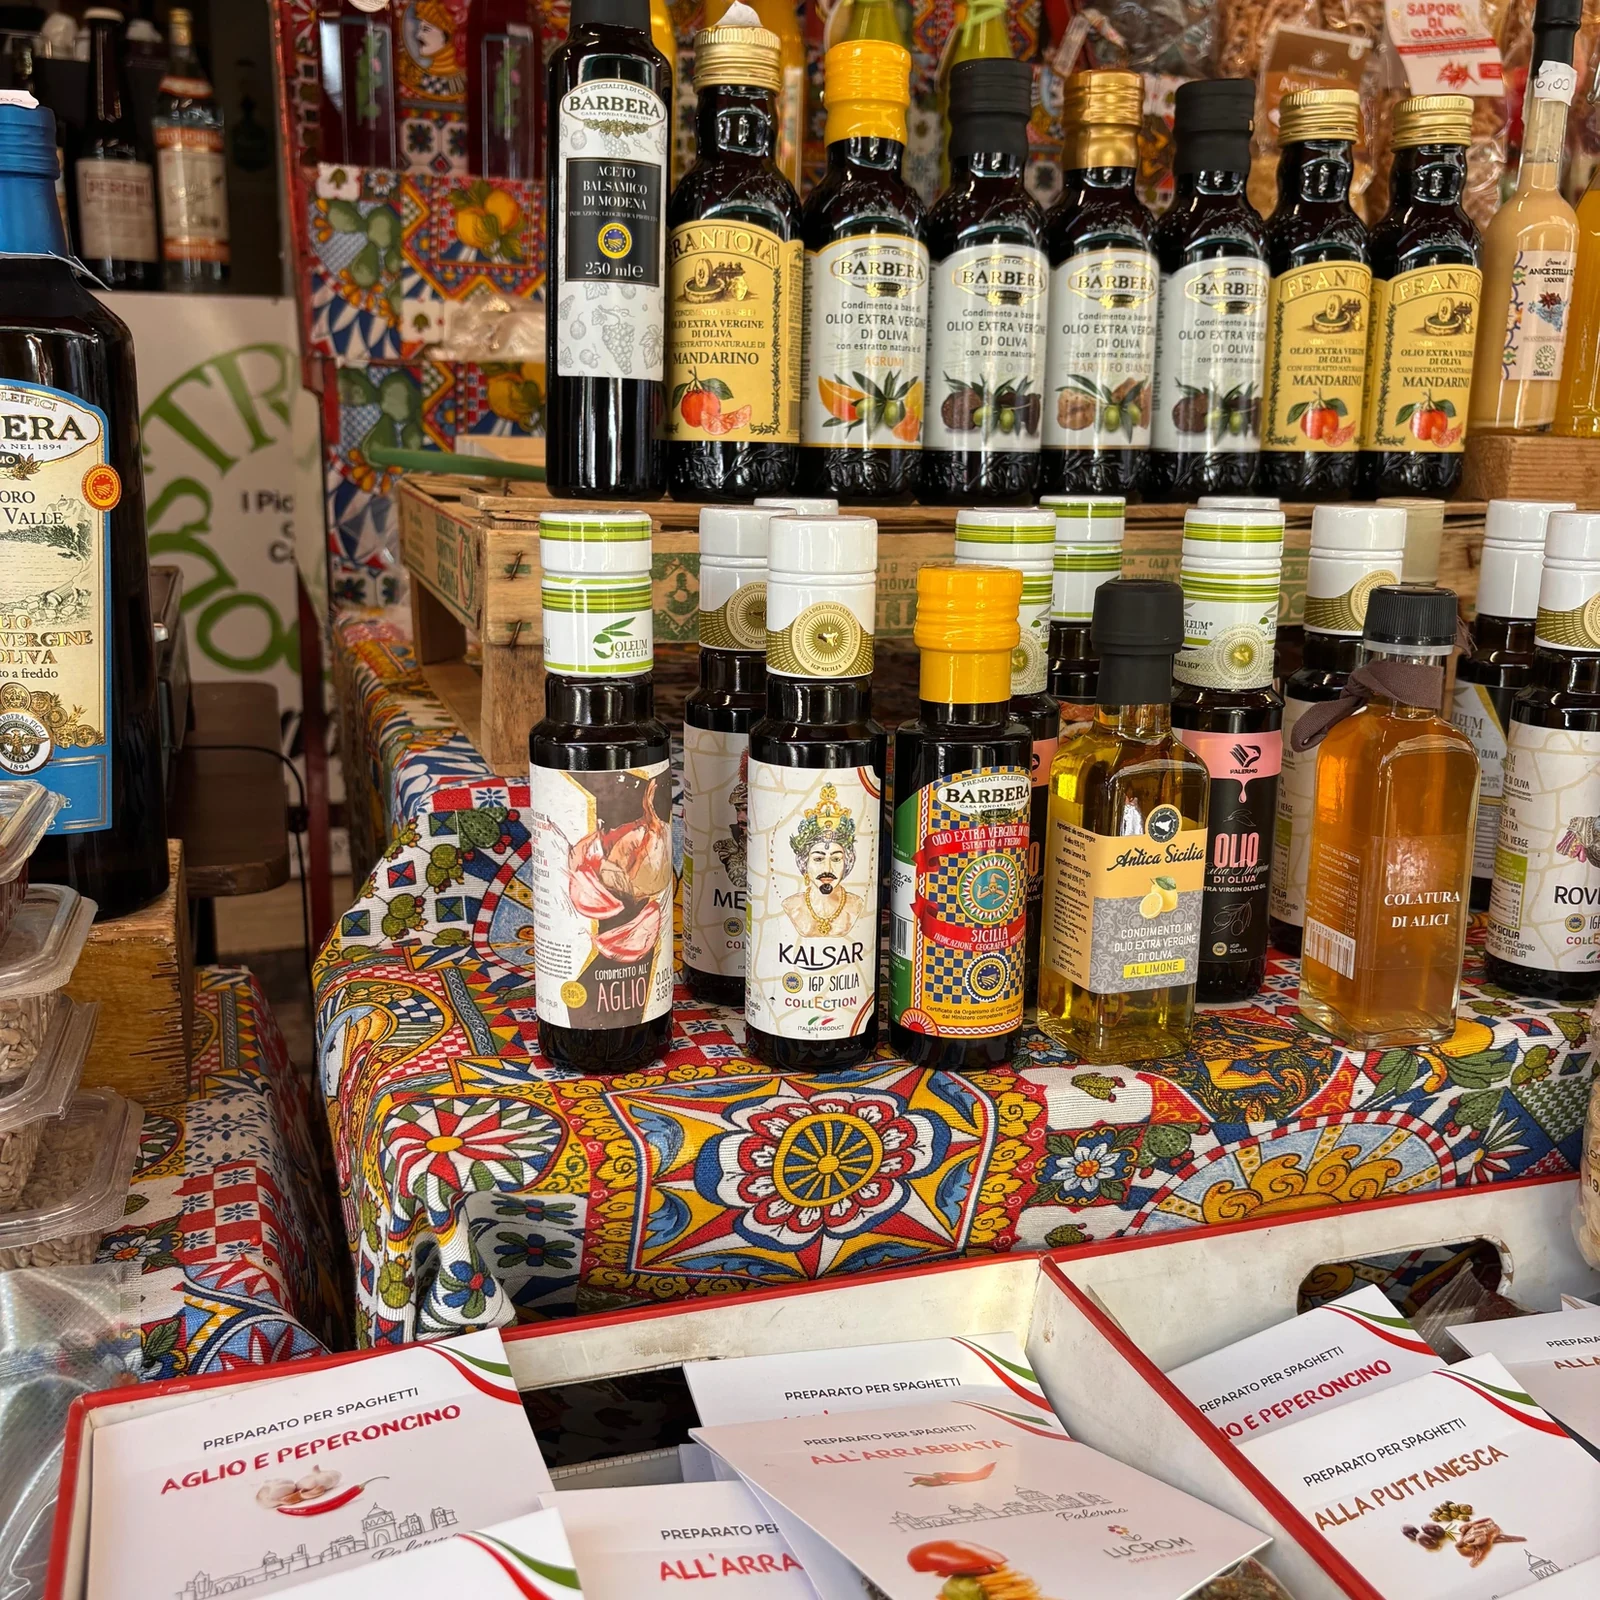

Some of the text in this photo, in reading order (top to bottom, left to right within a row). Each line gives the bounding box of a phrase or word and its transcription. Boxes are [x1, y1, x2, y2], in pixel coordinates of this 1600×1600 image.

[570, 95, 660, 119] BARBERA
[596, 165, 636, 179] ACETO
[582, 180, 648, 195] BALSAMICO
[583, 195, 648, 211] DI MODENA
[584, 261, 611, 276] 250
[840, 261, 924, 279] BARBERA
[1528, 267, 1550, 275] ANICE
[962, 270, 1044, 288] BARBERA
[1077, 275, 1155, 291] BARBERA
[841, 301, 892, 311] Condimento
[962, 309, 1012, 318] Condimento
[688, 319, 765, 329] EXTRA VERGINE
[825, 313, 854, 325] OLIO
[857, 314, 894, 326] EXTRA
[946, 321, 974, 331] OLIO
[978, 321, 1014, 332] EXTRA
[691, 330, 733, 339] DI OLIVA
[860, 329, 909, 341] DI OLIVA
[1062, 324, 1128, 335] OLIO EXTRA
[1178, 330, 1206, 341] OLIO
[1210, 330, 1243, 341] EXTRA
[714, 340, 755, 349] NATURALE
[854, 341, 888, 351] estratto
[980, 336, 1028, 347] DI OLIVA
[1096, 338, 1141, 349] DI OLIVA
[673, 352, 760, 365] MANDARINO
[1076, 351, 1091, 359] con
[1289, 347, 1314, 355] OLIO
[1315, 347, 1343, 356] EXTRA
[1400, 348, 1424, 357] OLIO
[1426, 348, 1454, 357] EXTRA
[864, 356, 905, 367] AGRUMI
[1318, 356, 1352, 364] DI OLIVA
[1429, 357, 1462, 366] DI OLIVA
[1292, 374, 1362, 387] MANDARINO
[3, 506, 65, 525] VALLE
[615, 638, 649, 652] OLEUM
[614, 650, 649, 660] SICILIA
[21, 666, 59, 679] freddo
[10, 762, 30, 771] 1894
[1230, 767, 1259, 775] PALERMO
[1514, 778, 1531, 790] OLIVA
[945, 783, 1030, 803] BARBERA
[932, 826, 1017, 847] OLIO EXTRA VERGINE
[1510, 836, 1529, 848] VERGE
[962, 839, 996, 851] ESTRATTO
[1214, 832, 1260, 868] OLIO
[1107, 842, 1205, 873] Antica Sicilia
[1213, 874, 1257, 884] DI OLIVA
[1384, 890, 1461, 907] COLATURA
[1391, 913, 1449, 928] DI ALICI
[970, 927, 1009, 943] SICILIA
[1121, 922, 1193, 940] CONDIMENTO IN
[1497, 925, 1520, 940] SICILIA
[933, 932, 1009, 951] INDICAZIONE GEOGRAFICA
[1114, 935, 1197, 953] OLIO EXTRA VERGINE
[779, 942, 863, 970] KALSAR
[1137, 949, 1173, 963] DI OLIVA
[1505, 946, 1527, 958] ITALIA
[594, 965, 636, 981] CONDIMENTO
[1130, 960, 1179, 975] AL LIMONE
[808, 972, 860, 992] IGP SICILIA
[596, 976, 647, 1013] AGLIO
[784, 996, 857, 1012] COLLECTION
[797, 1024, 819, 1032] ITALIAN
[1260, 1346, 1344, 1388] PER SPAGHETTI
[784, 1377, 962, 1401] PREPARATO PER SPAGHETTI
[1243, 1358, 1392, 1431] E PEPERONCINO
[203, 1386, 421, 1451] PREPARATO PER SPAGHETTI
[803, 1424, 977, 1447] PREPARATO PER SPAGHETTI
[160, 1402, 463, 1496] AGLIO E PEPERONCINO
[810, 1438, 1014, 1466] ALL'ARRABBIATA
[1302, 1417, 1467, 1487] PREPARATO PER SPAGHETTI
[1313, 1444, 1510, 1531] ALLA PUTTANESCA
[1055, 1507, 1129, 1522] Palermo
[661, 1524, 753, 1541] PREPARATO
[1102, 1537, 1193, 1559] LUCROM
